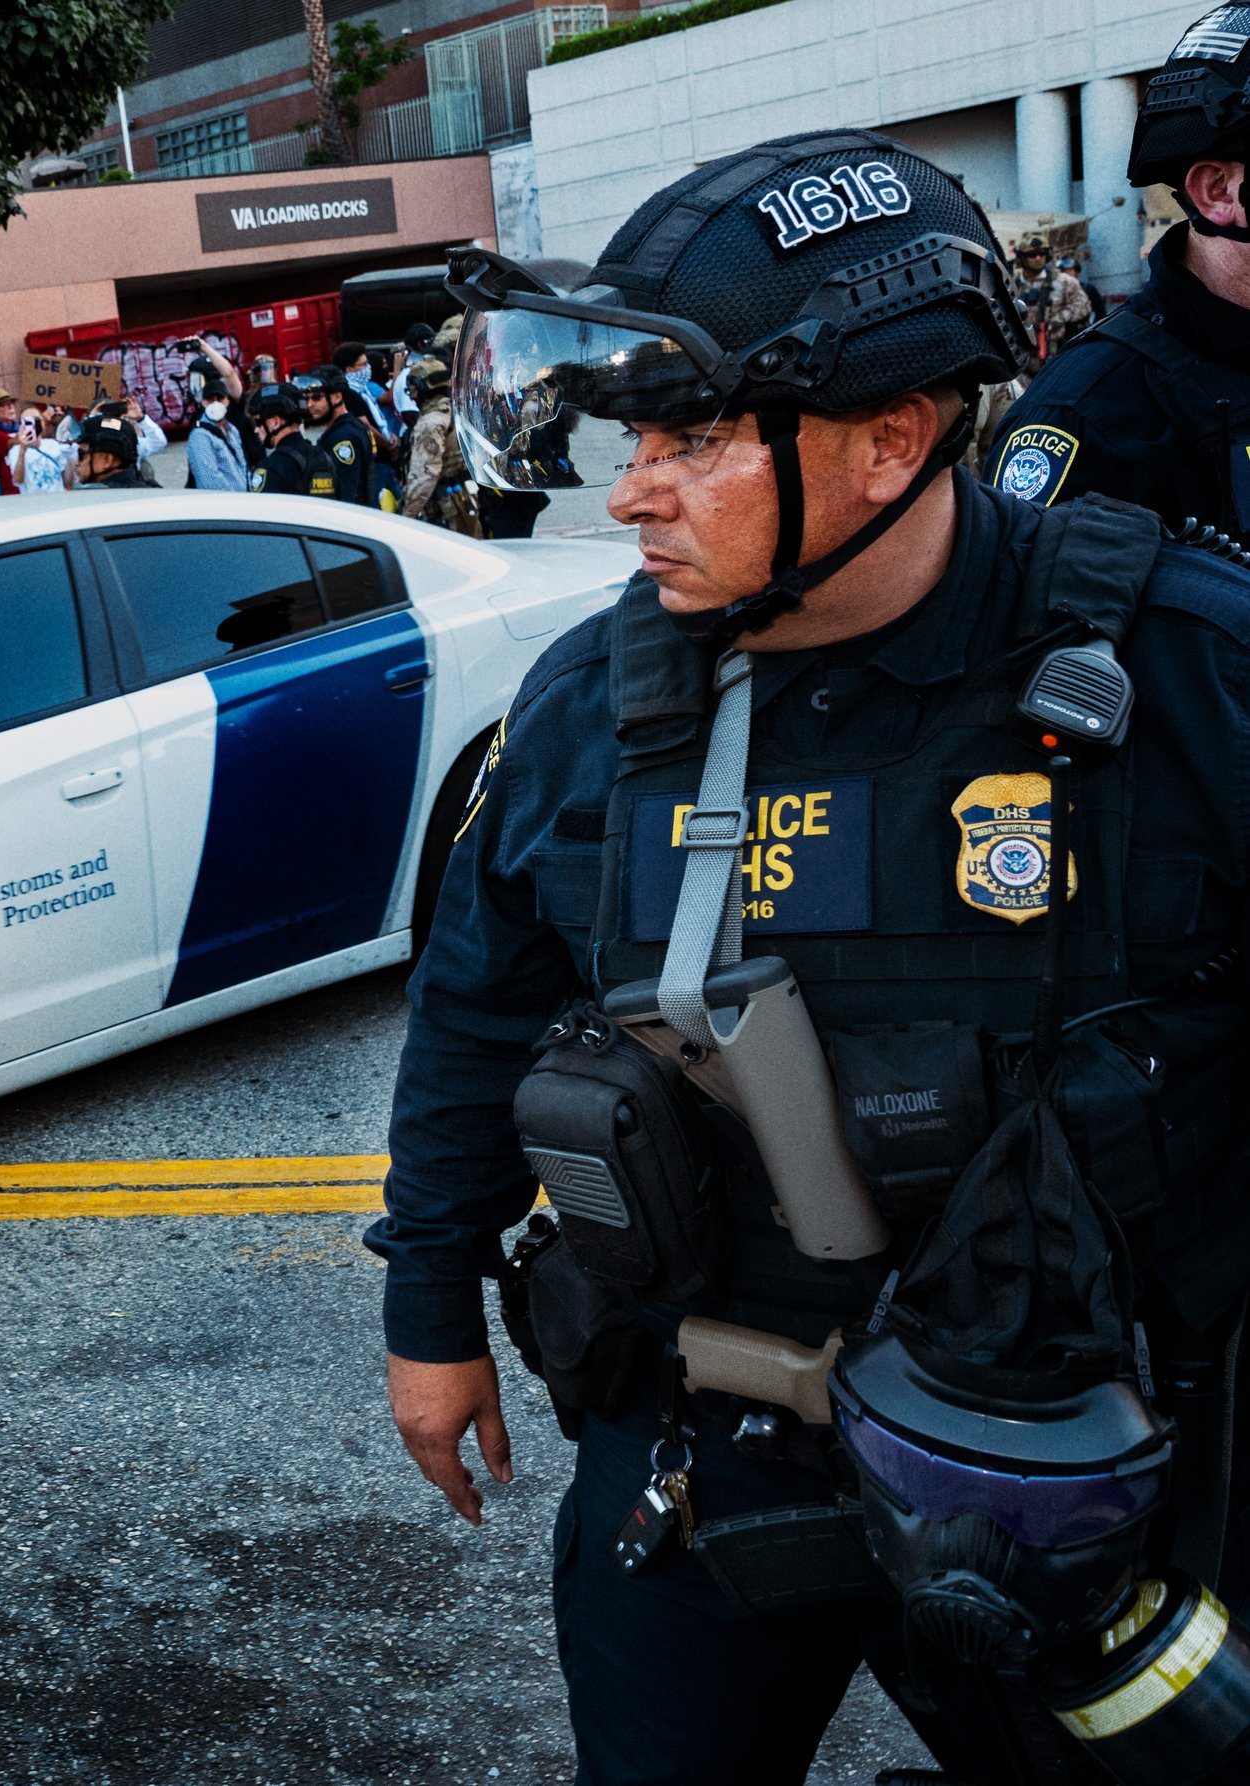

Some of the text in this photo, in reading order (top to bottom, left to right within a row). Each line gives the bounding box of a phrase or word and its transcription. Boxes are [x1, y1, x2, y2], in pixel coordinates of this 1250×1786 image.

[230, 199, 369, 230] VA LOADING DOCKS
[758, 161, 911, 249] 1616
[34, 358, 103, 378] ICE OUT
[35, 384, 56, 397] OF
[1012, 431, 1070, 458] POLICE
[614, 449, 688, 472] REISION
[1036, 699, 1085, 721] MOTOROLA
[671, 791, 832, 847] PICE
[993, 806, 1031, 820] DHS
[970, 827, 997, 839] FEDERAL
[996, 824, 1031, 834] PROTECTIVE
[70, 848, 109, 880] and
[741, 843, 795, 892] HS
[3, 881, 116, 929] Protection
[741, 900, 775, 920] 16
[993, 895, 1044, 908] POLICE
[855, 1089, 942, 1117] NALOXONE
